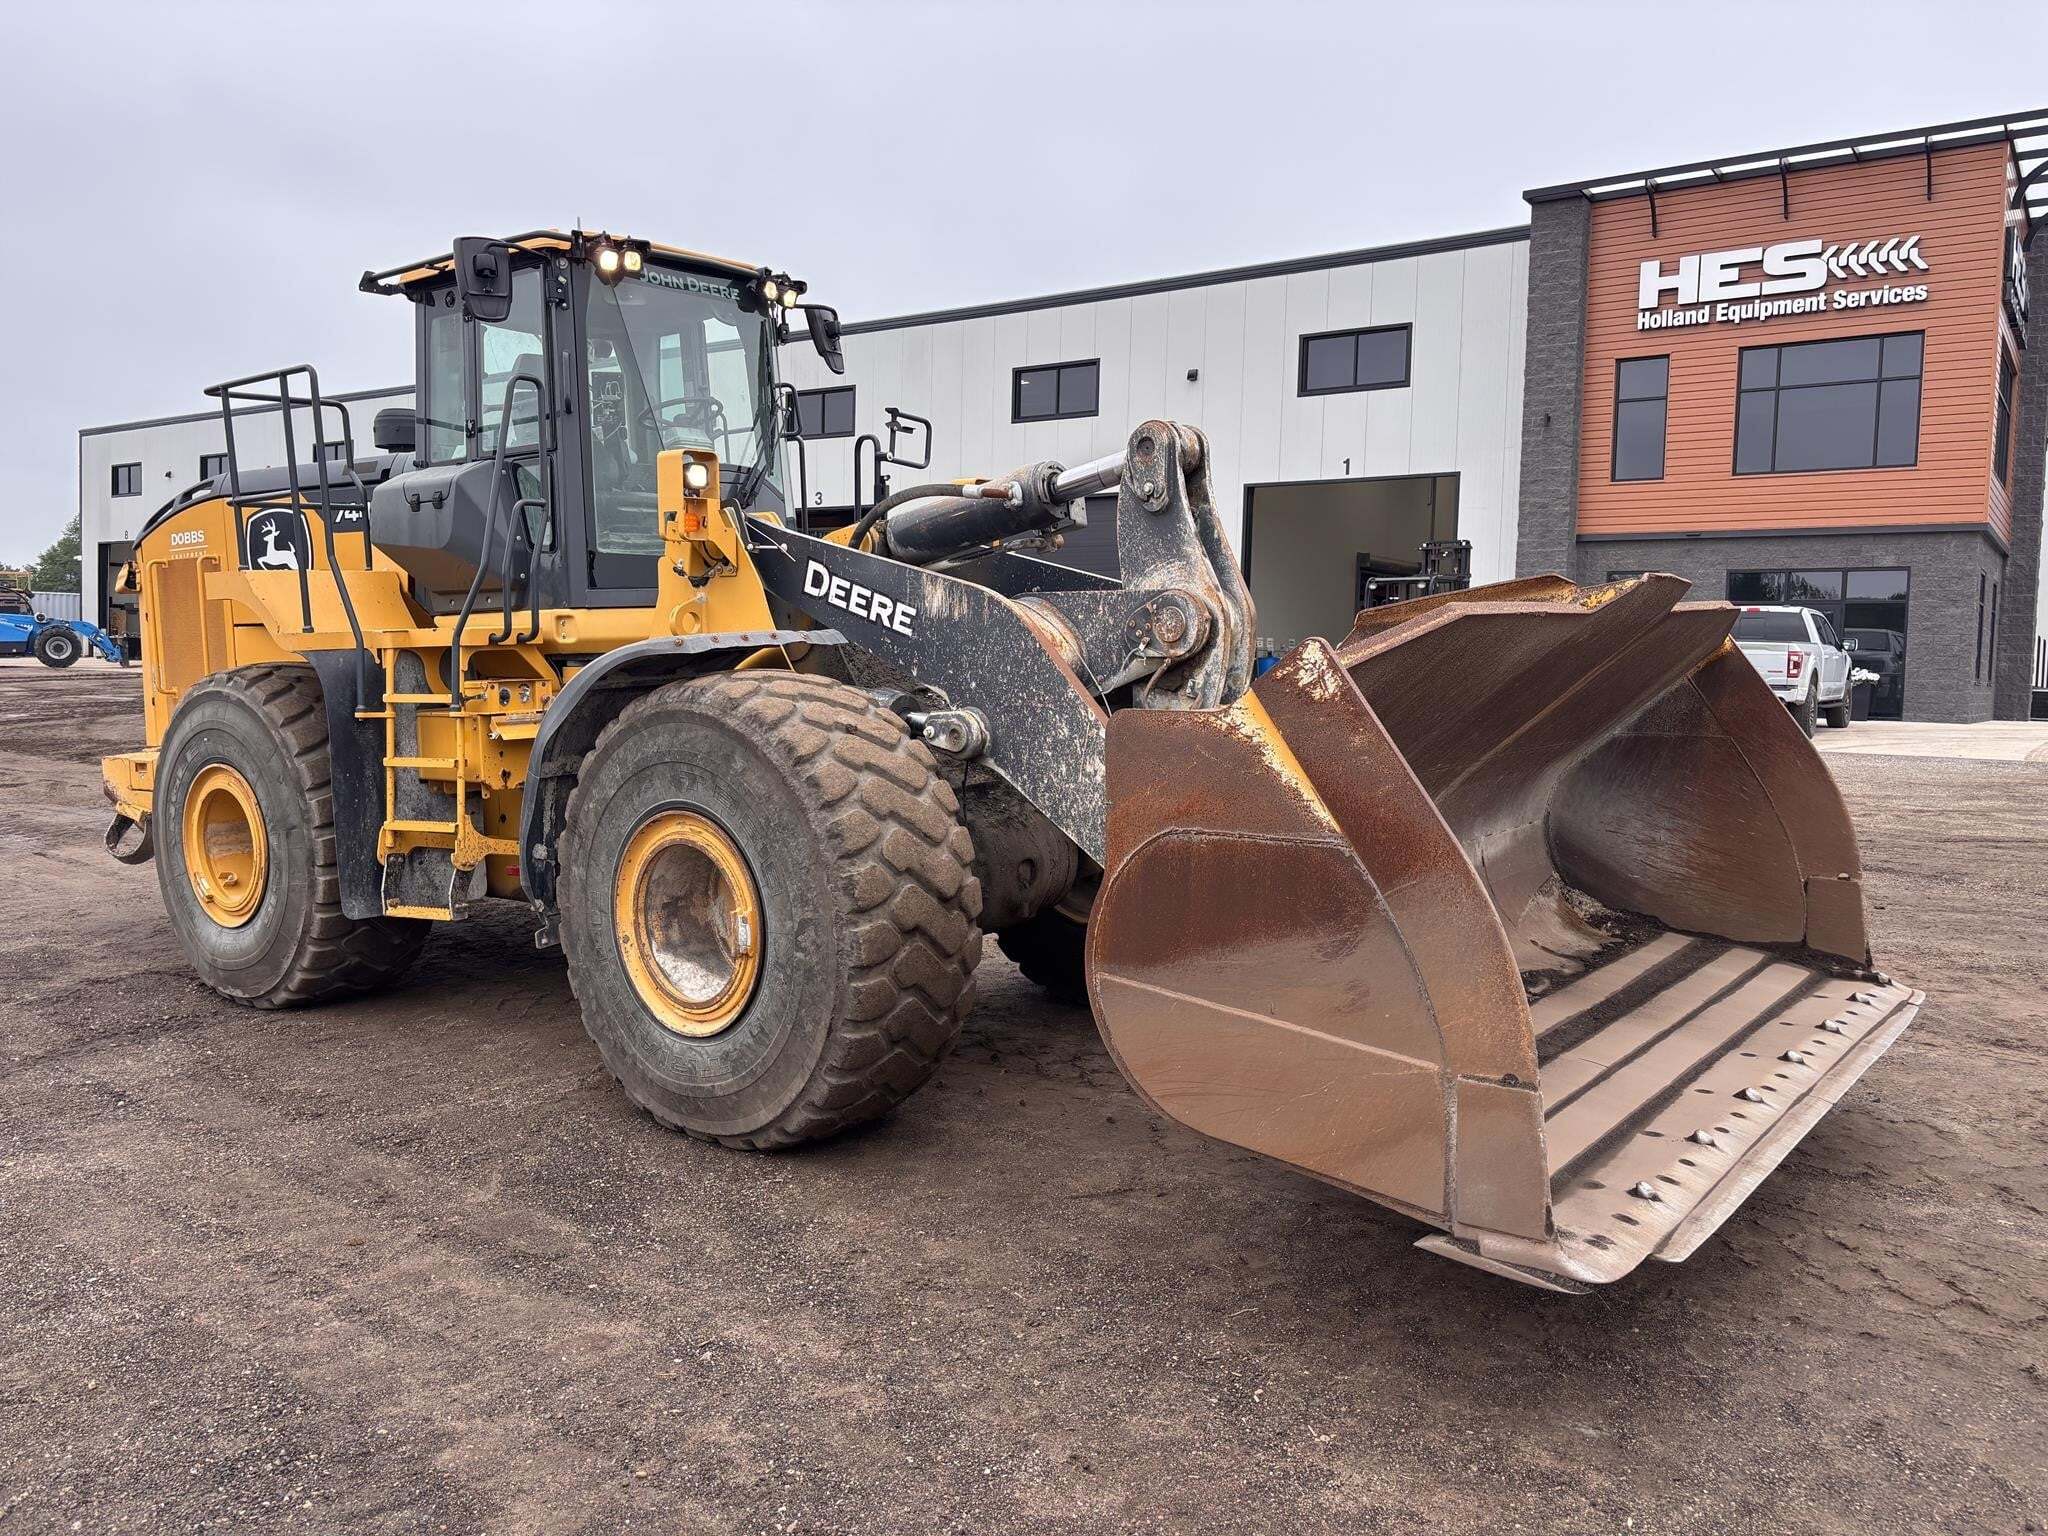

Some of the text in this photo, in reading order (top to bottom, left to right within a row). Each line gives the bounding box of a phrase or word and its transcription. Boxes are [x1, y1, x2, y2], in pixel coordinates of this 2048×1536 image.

[640, 267, 740, 300] JOHN DEERE
[1639, 239, 1828, 309] HES
[1637, 284, 1928, 330] Holland Equipment Services
[1343, 458, 1350, 475] 1
[814, 491, 823, 505] 3
[171, 530, 205, 545] DOBBS
[804, 560, 917, 637] DEERE
